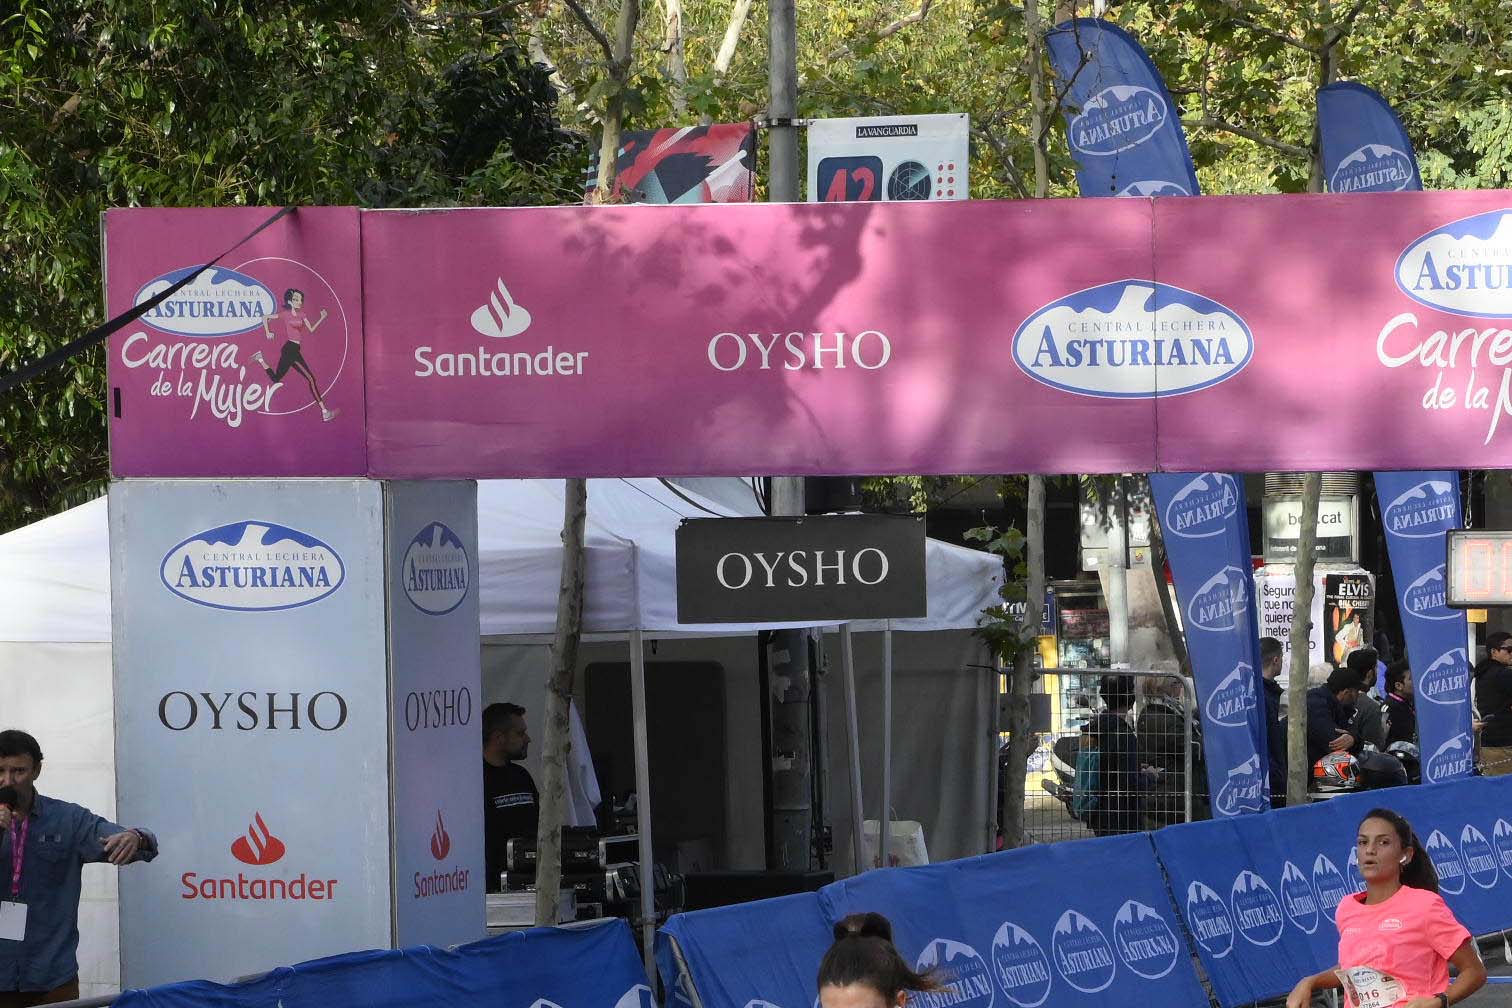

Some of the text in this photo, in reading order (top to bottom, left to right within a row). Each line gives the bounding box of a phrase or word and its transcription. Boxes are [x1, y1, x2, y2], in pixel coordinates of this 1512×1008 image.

[146, 291, 265, 318] ASTURIANA
[215, 288, 262, 297] LECHERA
[1068, 319, 1226, 333] CENTRAL LECHERA
[122, 332, 239, 369] Carrera
[414, 346, 589, 377] Santander
[708, 330, 892, 371] OYSHO
[1031, 325, 1235, 367] ASTURIANA
[151, 366, 284, 428] de la Mujer
[1423, 372, 1457, 410] de
[1464, 369, 1490, 410] la
[175, 554, 331, 588] ASTURIANA
[203, 551, 325, 562] CENTRAL LECHERA
[716, 547, 889, 590] OYSHO
[407, 556, 466, 592] ASTURIANA
[1339, 583, 1369, 596] ELVIS
[1264, 600, 1280, 611] que
[158, 691, 348, 731] OYSHO
[405, 686, 472, 732] OYSHO
[181, 871, 338, 900] Santander
[414, 866, 470, 899] Santander
